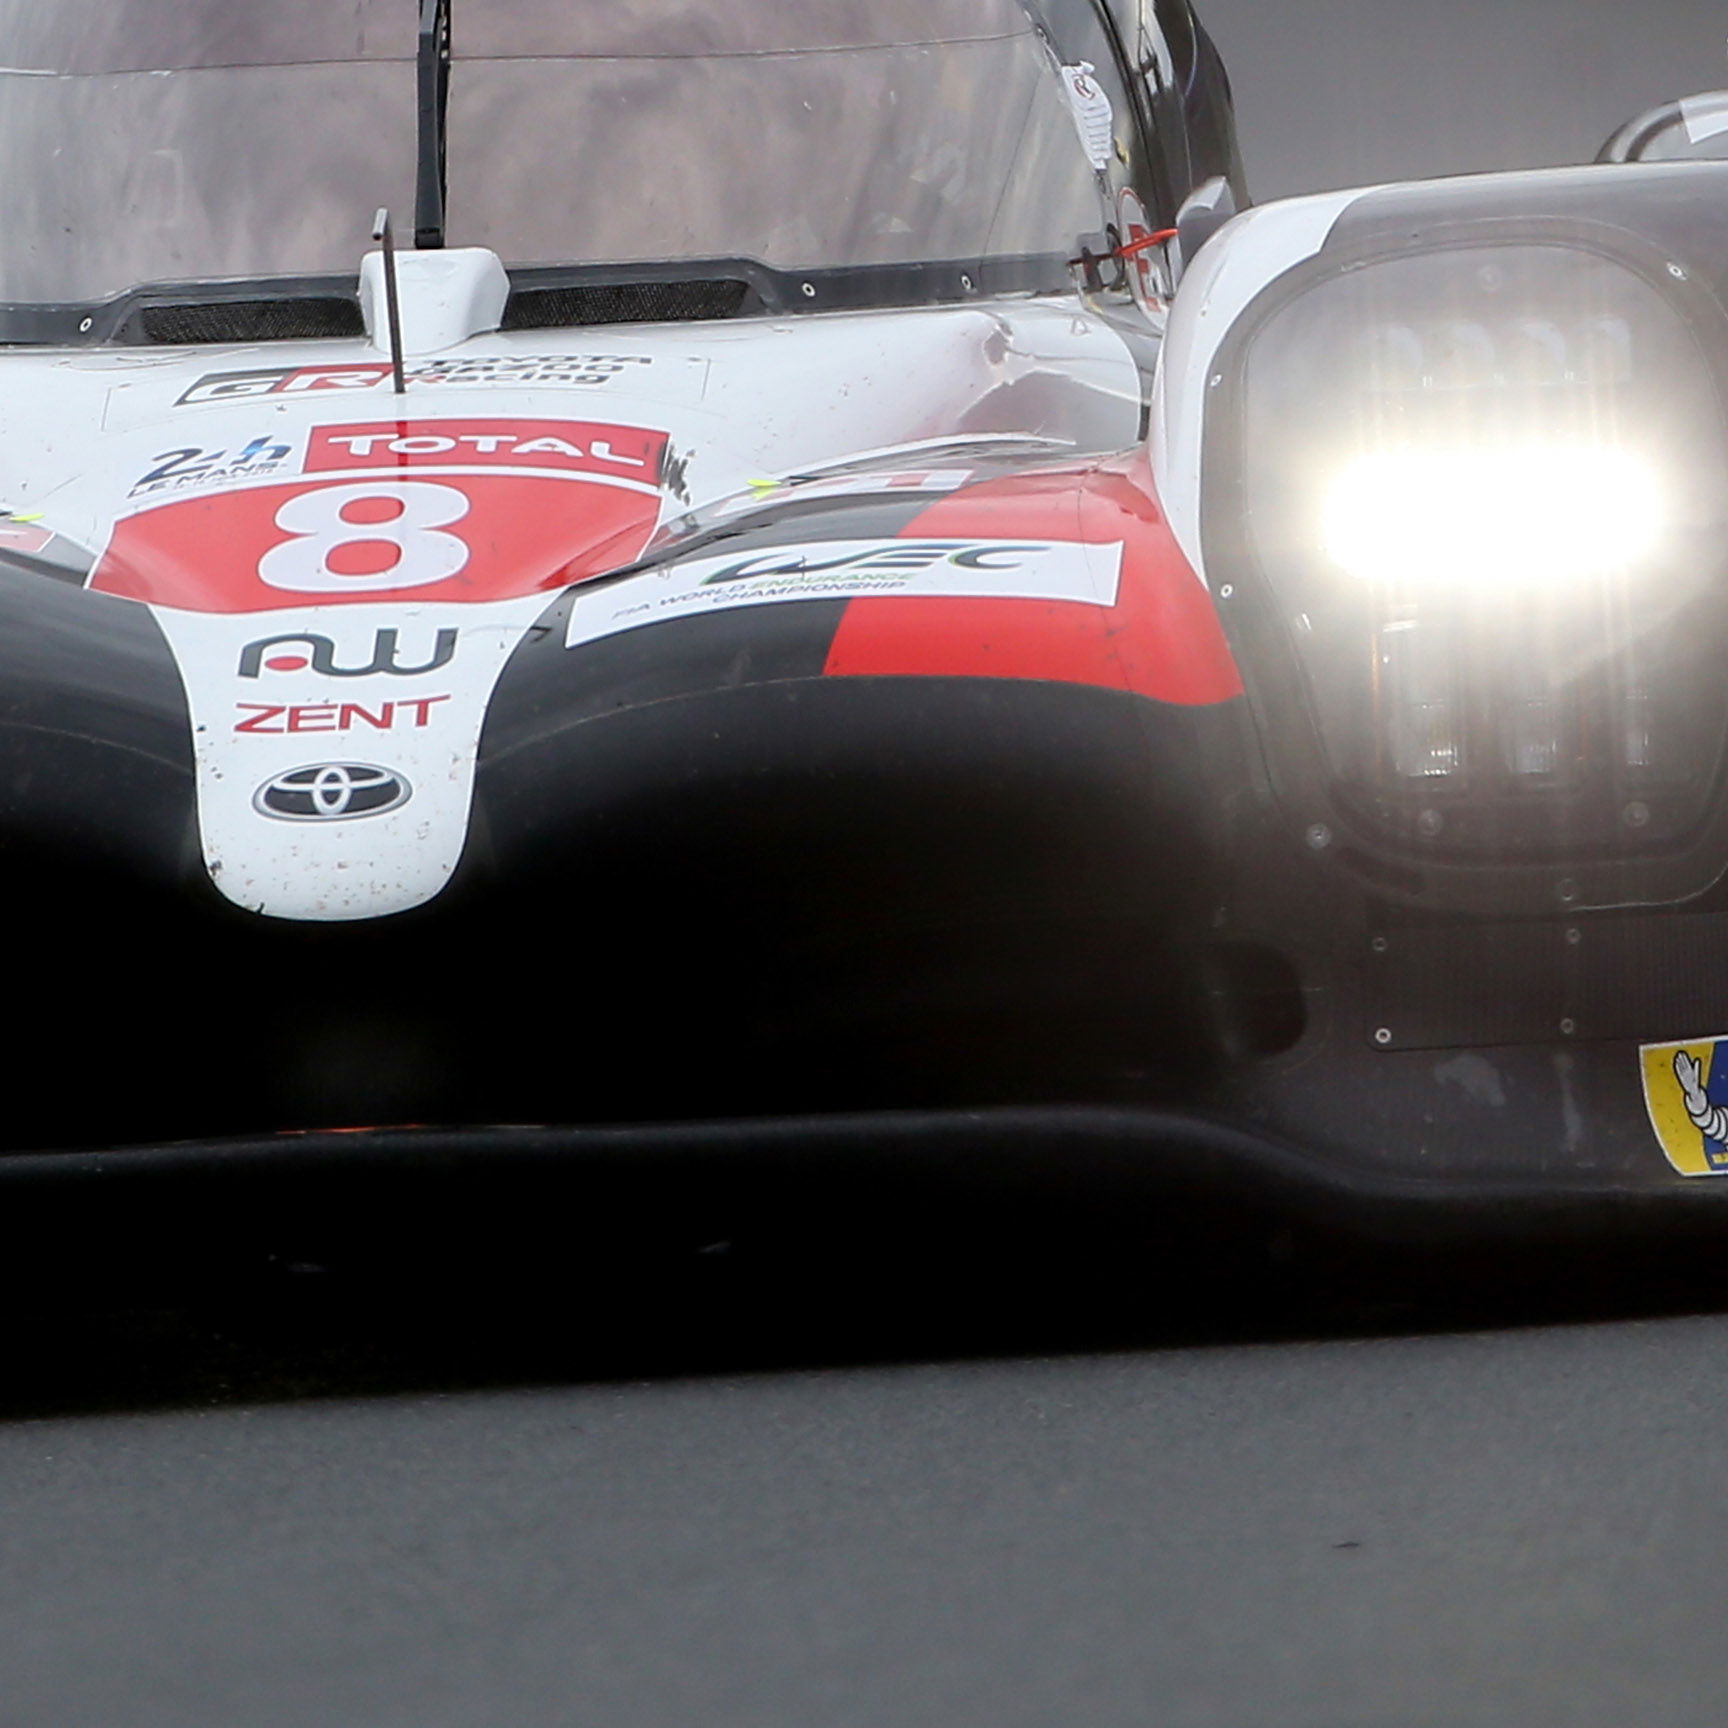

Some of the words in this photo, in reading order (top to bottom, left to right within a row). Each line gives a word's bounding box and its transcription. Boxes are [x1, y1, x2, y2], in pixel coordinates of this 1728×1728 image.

[425, 355, 653, 366] TOYOTA
[327, 434, 646, 467] TOTAL
[127, 480, 170, 499] LE
[258, 482, 471, 593] 8
[700, 543, 1052, 585] WEC
[612, 603, 651, 620] FIA
[659, 584, 748, 606] WORLD
[749, 573, 917, 590] ENDURANCE
[713, 581, 907, 604] CHAMPIONSHIP
[233, 693, 452, 734] ZENT
